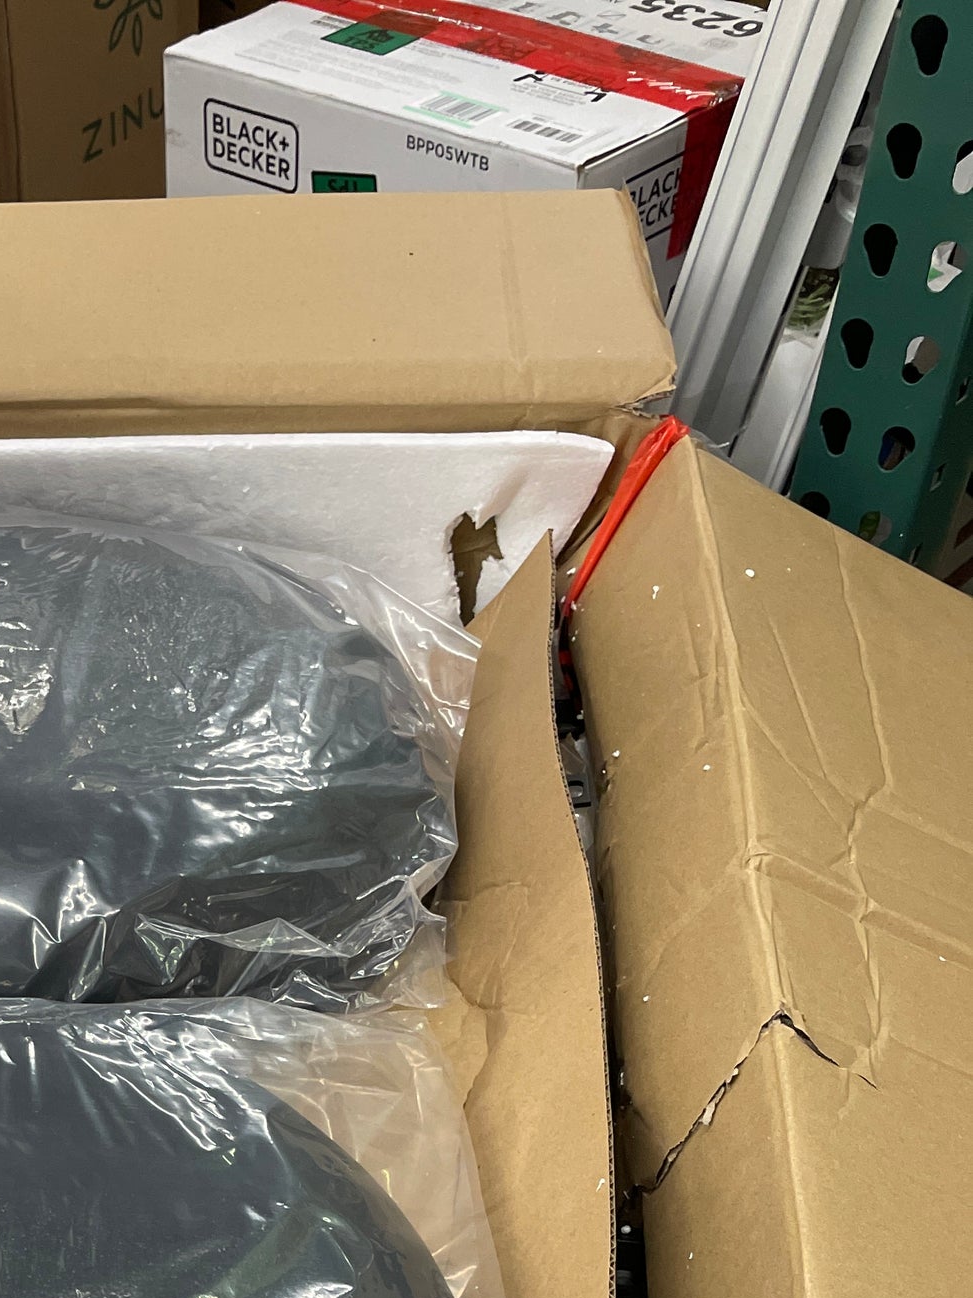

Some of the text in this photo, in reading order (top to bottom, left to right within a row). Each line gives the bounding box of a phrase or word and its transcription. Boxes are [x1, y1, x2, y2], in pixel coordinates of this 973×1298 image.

[212, 112, 290, 153] BLACK+
[405, 134, 490, 172] BPP05WTB
[212, 137, 291, 181] DECKER
